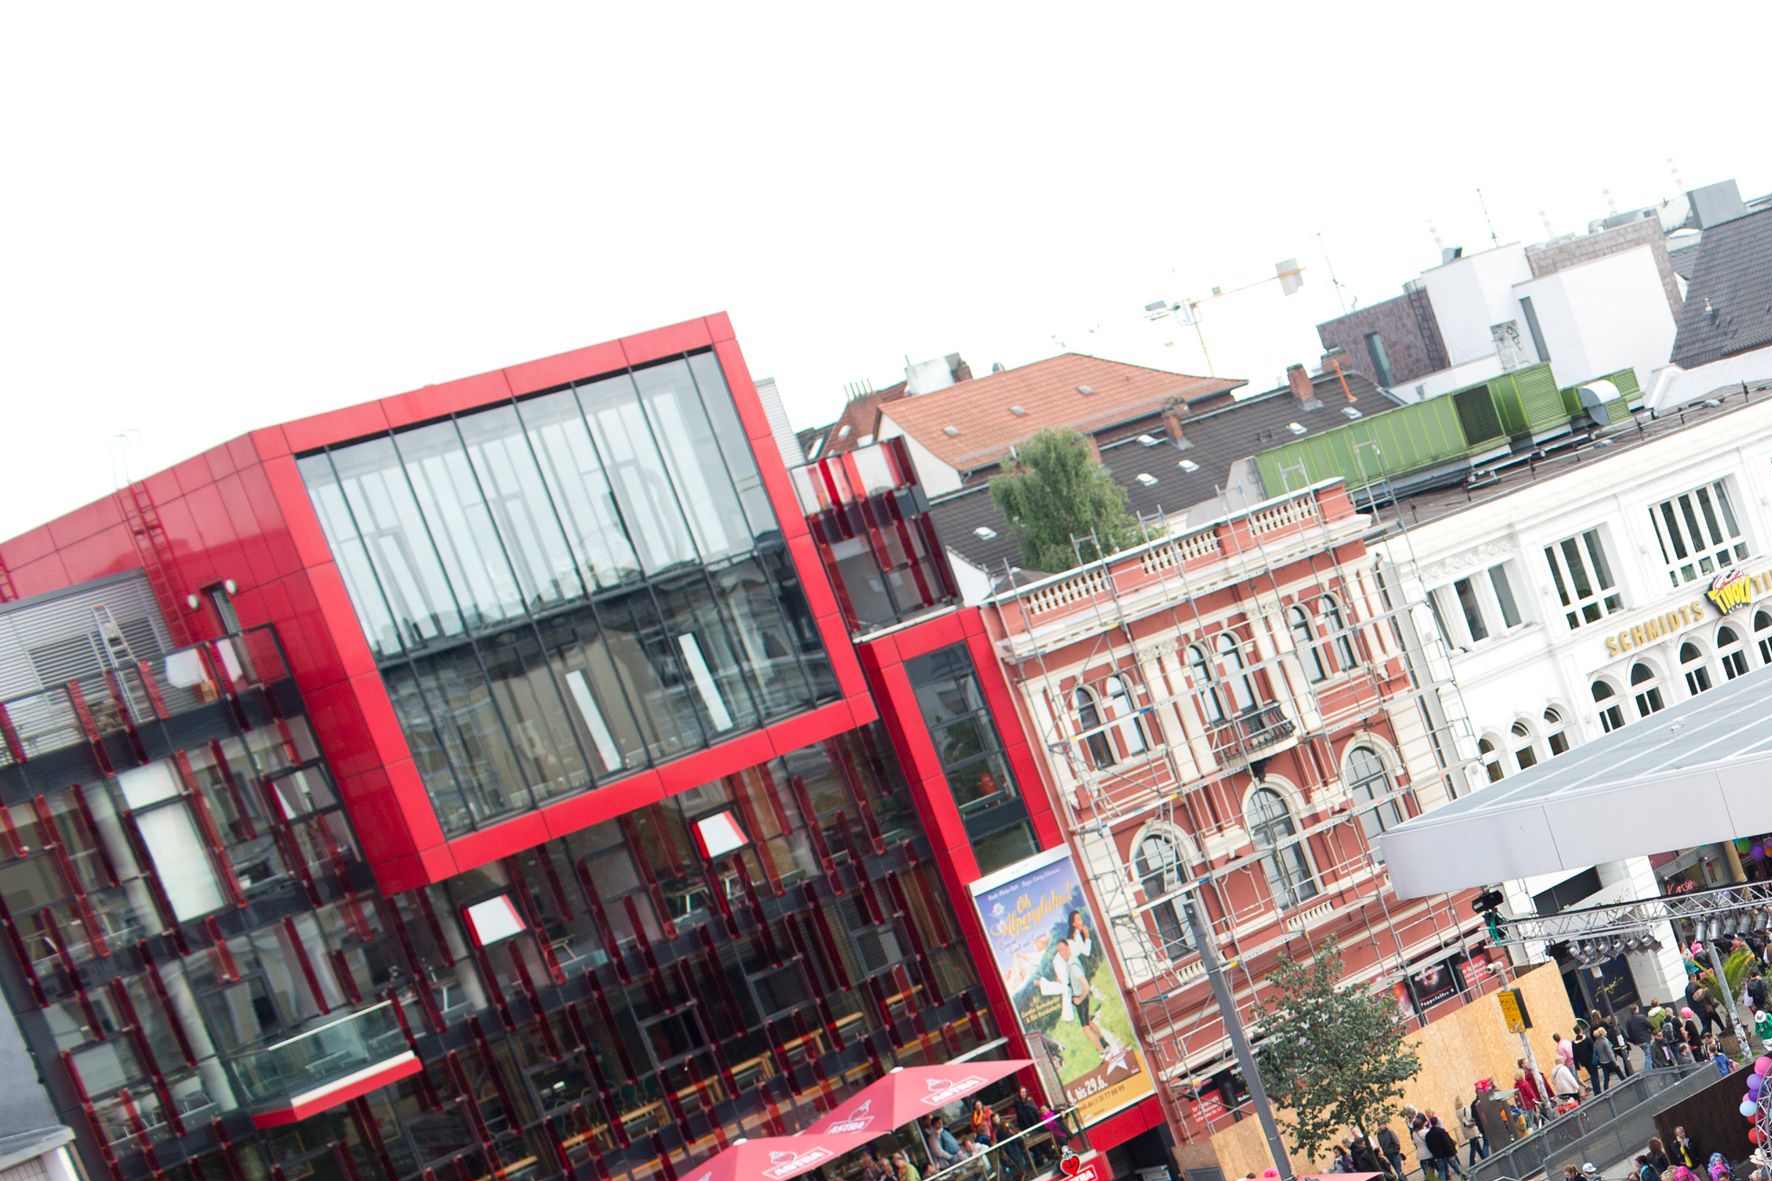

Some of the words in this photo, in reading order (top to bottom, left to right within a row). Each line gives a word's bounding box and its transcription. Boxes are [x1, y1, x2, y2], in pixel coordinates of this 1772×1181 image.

[1708, 575, 1752, 616] TIVOLI
[1604, 601, 1705, 658] SCHMIDTS
[930, 1078, 982, 1104] ASTRA
[828, 1118, 866, 1134] ASTRA
[776, 1150, 829, 1176] ASTRA
